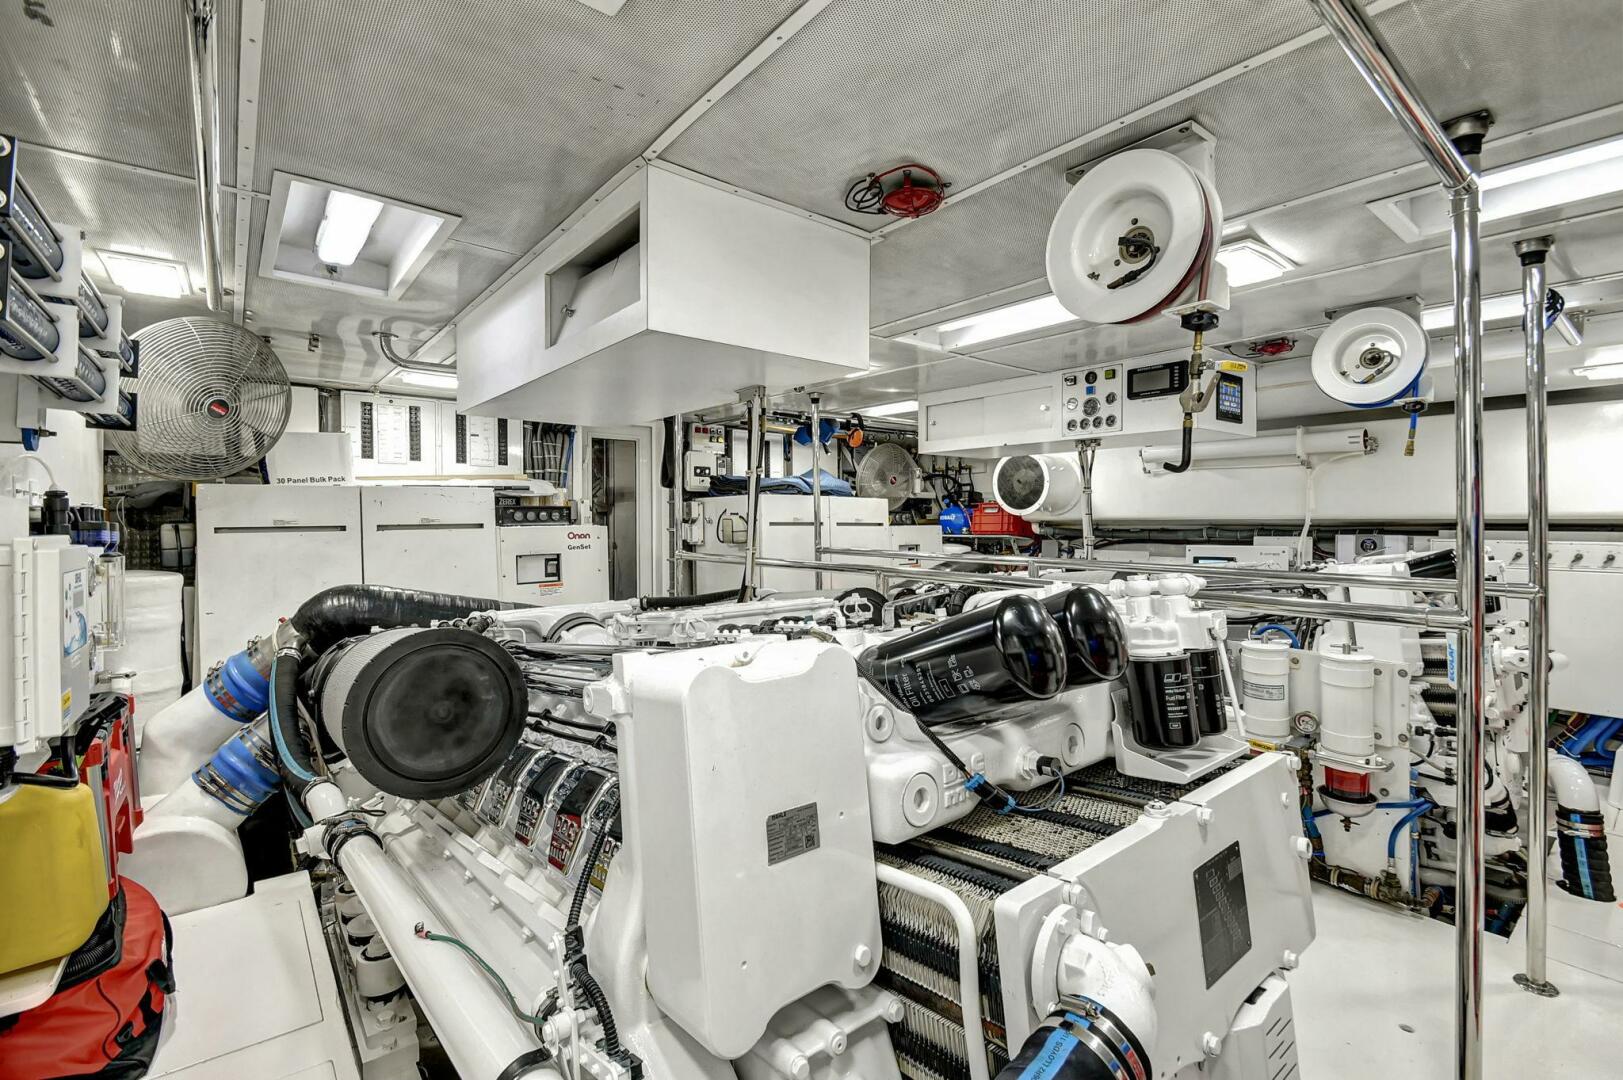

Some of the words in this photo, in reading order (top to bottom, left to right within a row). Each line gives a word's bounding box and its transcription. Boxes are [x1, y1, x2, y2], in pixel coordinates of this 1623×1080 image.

[276, 477, 286, 485] 30
[287, 476, 309, 484] Panel
[901, 673, 916, 694] Filter
[908, 692, 921, 707] Oil
[1043, 1041, 1064, 1068] LLOYDS
